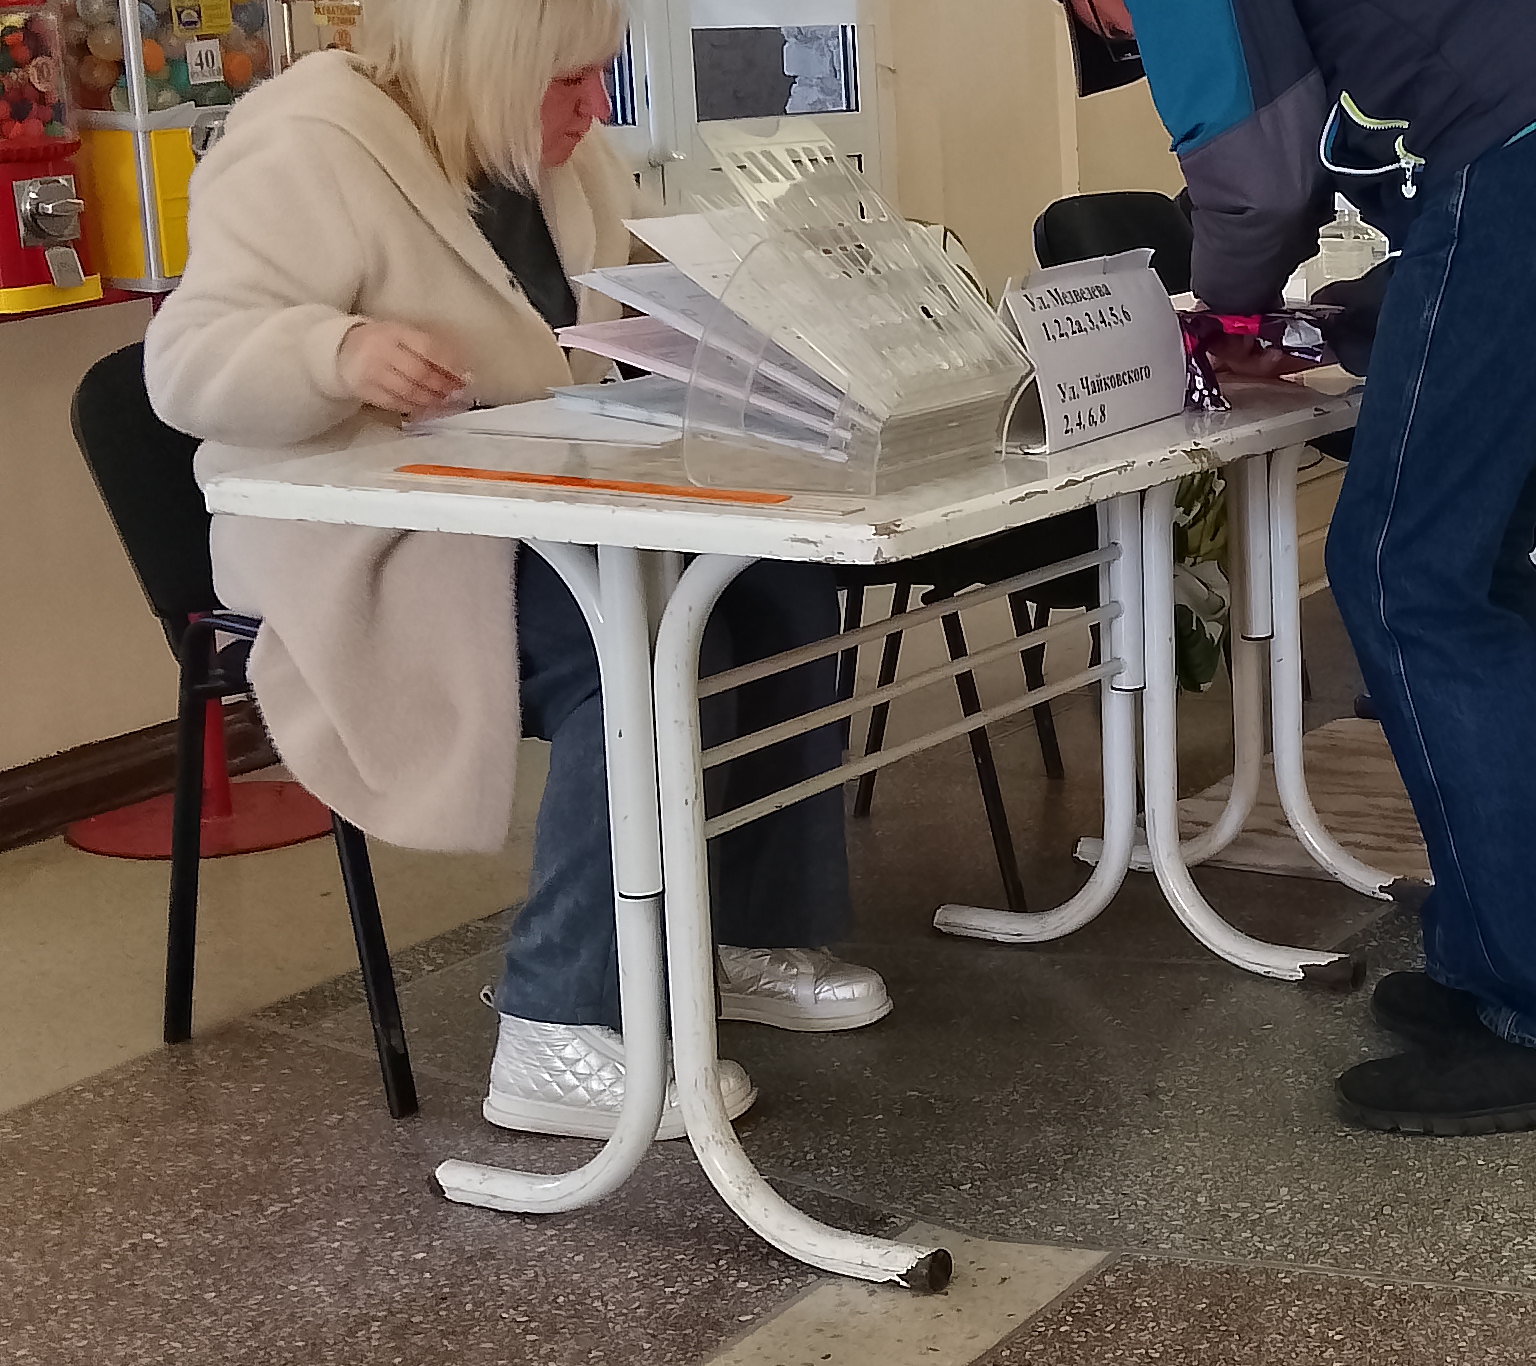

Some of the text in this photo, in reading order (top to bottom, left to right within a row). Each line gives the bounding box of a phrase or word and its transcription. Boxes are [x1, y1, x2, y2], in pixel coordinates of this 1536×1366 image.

[194, 48, 215, 72] 40
[1023, 283, 1112, 312] Ул. Медведева
[1056, 365, 1151, 403] Ул. Чайковского
